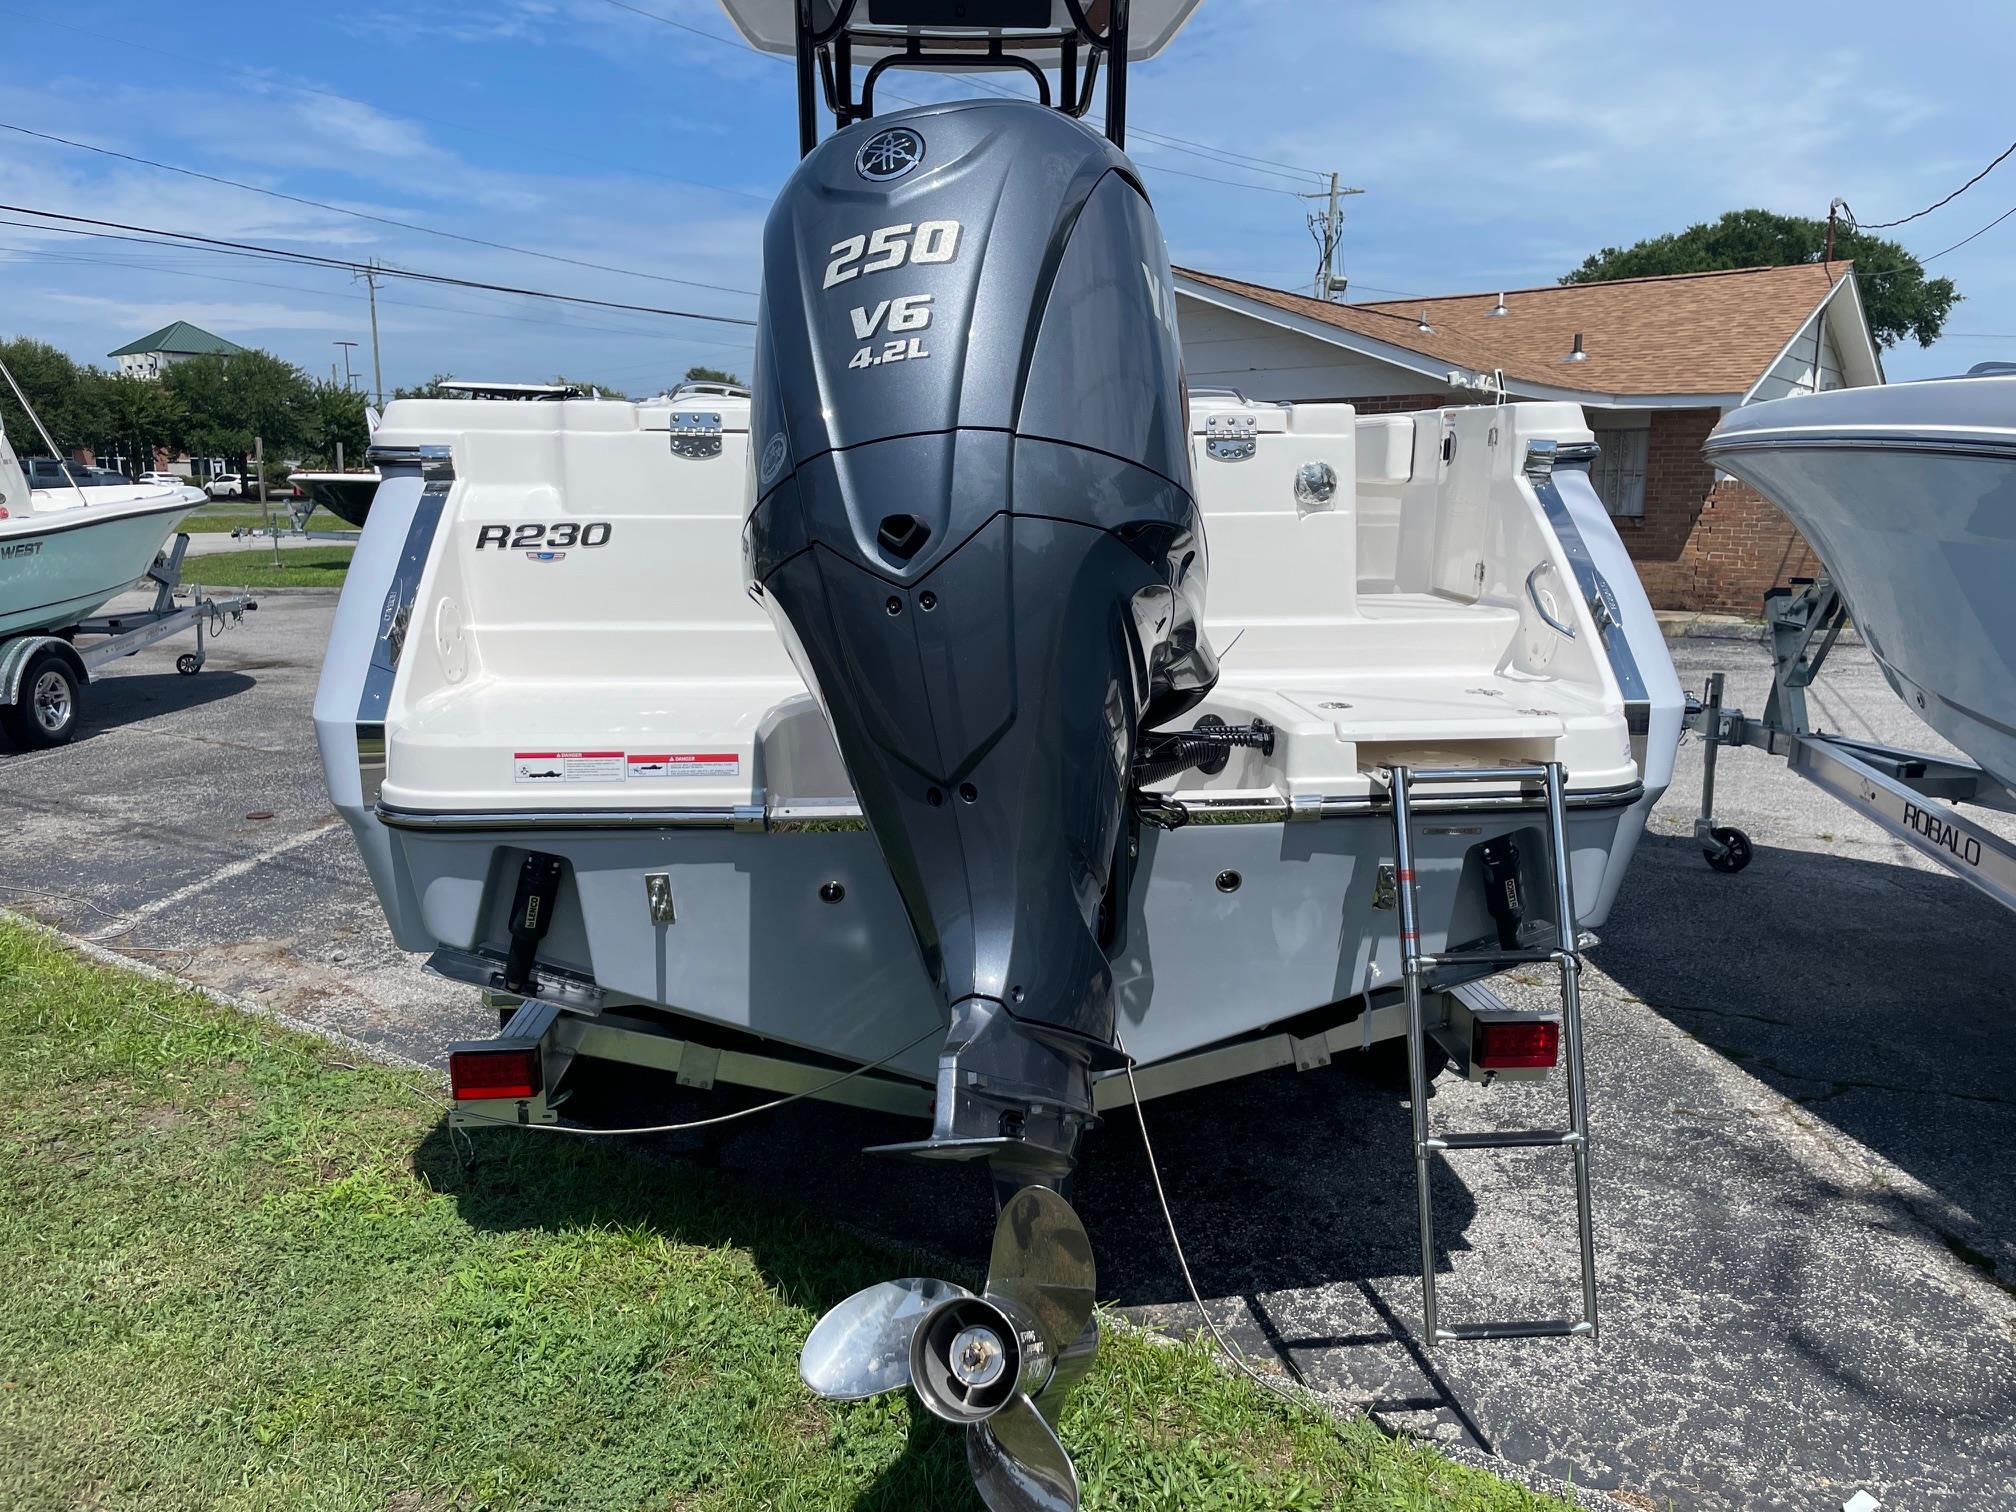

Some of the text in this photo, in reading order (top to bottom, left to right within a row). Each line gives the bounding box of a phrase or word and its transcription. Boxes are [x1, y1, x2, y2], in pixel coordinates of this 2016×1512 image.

[823, 220, 961, 290] 250
[850, 293, 932, 340] V6
[848, 337, 930, 369] 4.2L
[1, 541, 43, 560] WEST
[475, 522, 613, 551] R230
[1903, 802, 1981, 867] ROBALO
[527, 897, 539, 922] LENCO
